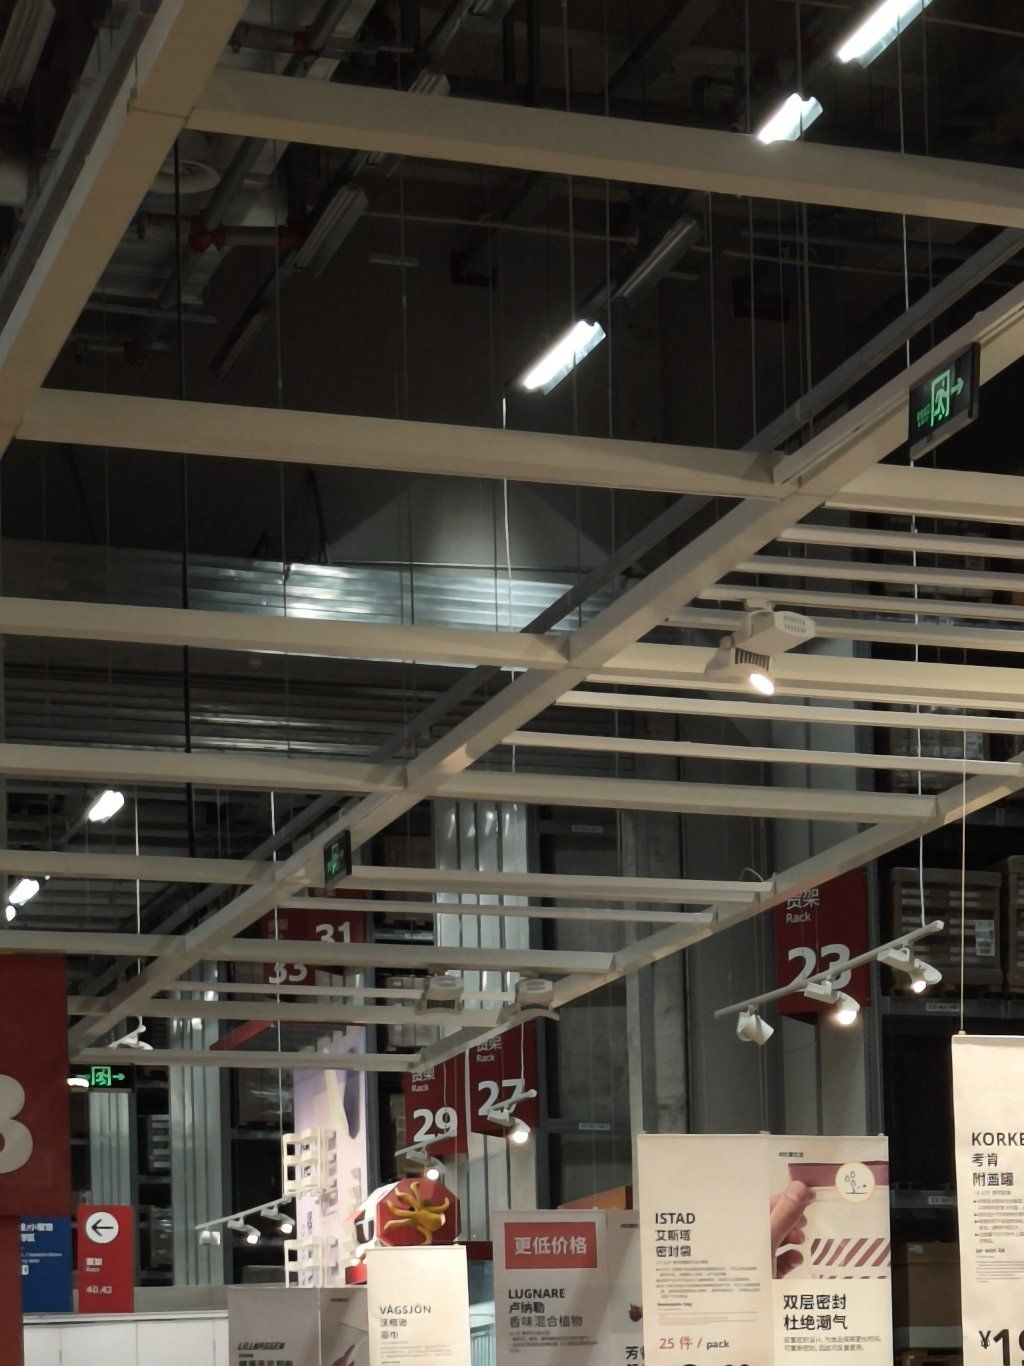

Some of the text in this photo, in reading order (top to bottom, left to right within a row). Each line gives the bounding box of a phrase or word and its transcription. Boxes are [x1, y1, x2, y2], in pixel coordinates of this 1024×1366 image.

[786, 911, 812, 923] Rack
[788, 943, 852, 992] 23
[478, 1078, 526, 1117] 27
[413, 1106, 458, 1142] 29
[971, 1153, 998, 1167] 考肯
[655, 1213, 696, 1224] ISTAD
[514, 1236, 588, 1255] 更低价格
[508, 1288, 566, 1299] LUGNARE
[783, 1293, 846, 1310] 双层密封
[784, 1314, 848, 1330] 杜绝潮气
[659, 1338, 674, 1349] 25
[706, 1340, 729, 1350] pack
